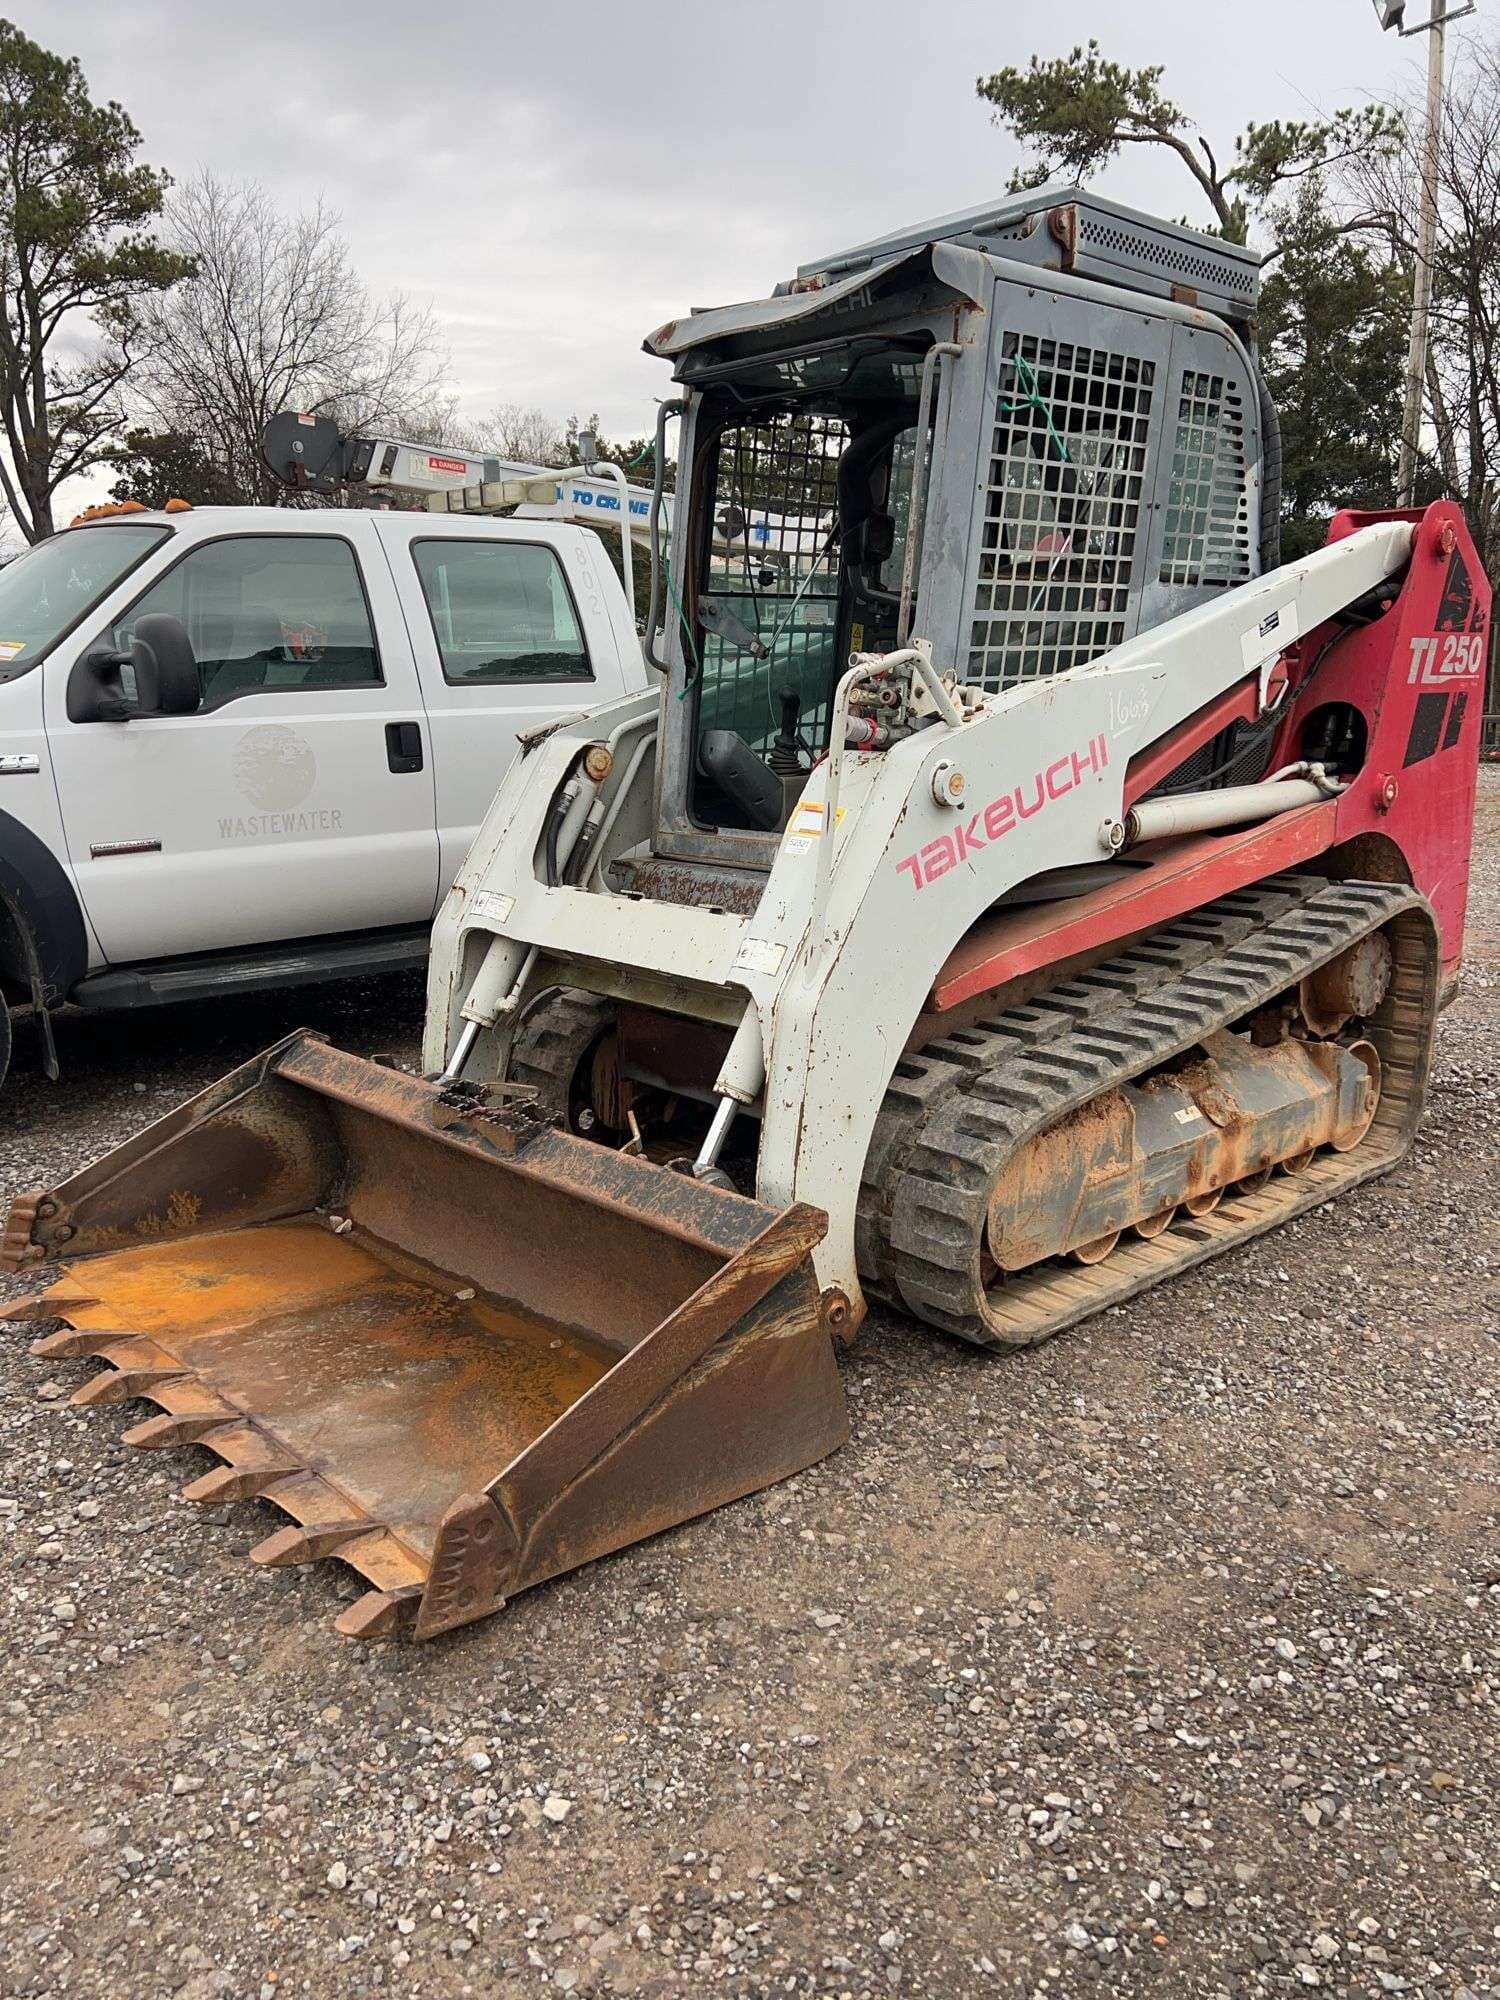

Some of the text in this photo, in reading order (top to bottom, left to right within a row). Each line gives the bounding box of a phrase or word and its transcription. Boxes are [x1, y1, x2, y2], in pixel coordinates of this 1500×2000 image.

[439, 460, 464, 471] DANGER
[1407, 635, 1483, 684] TL250
[217, 809, 343, 838] WASTEWATER
[896, 733, 1109, 891] TAKEUCHI
